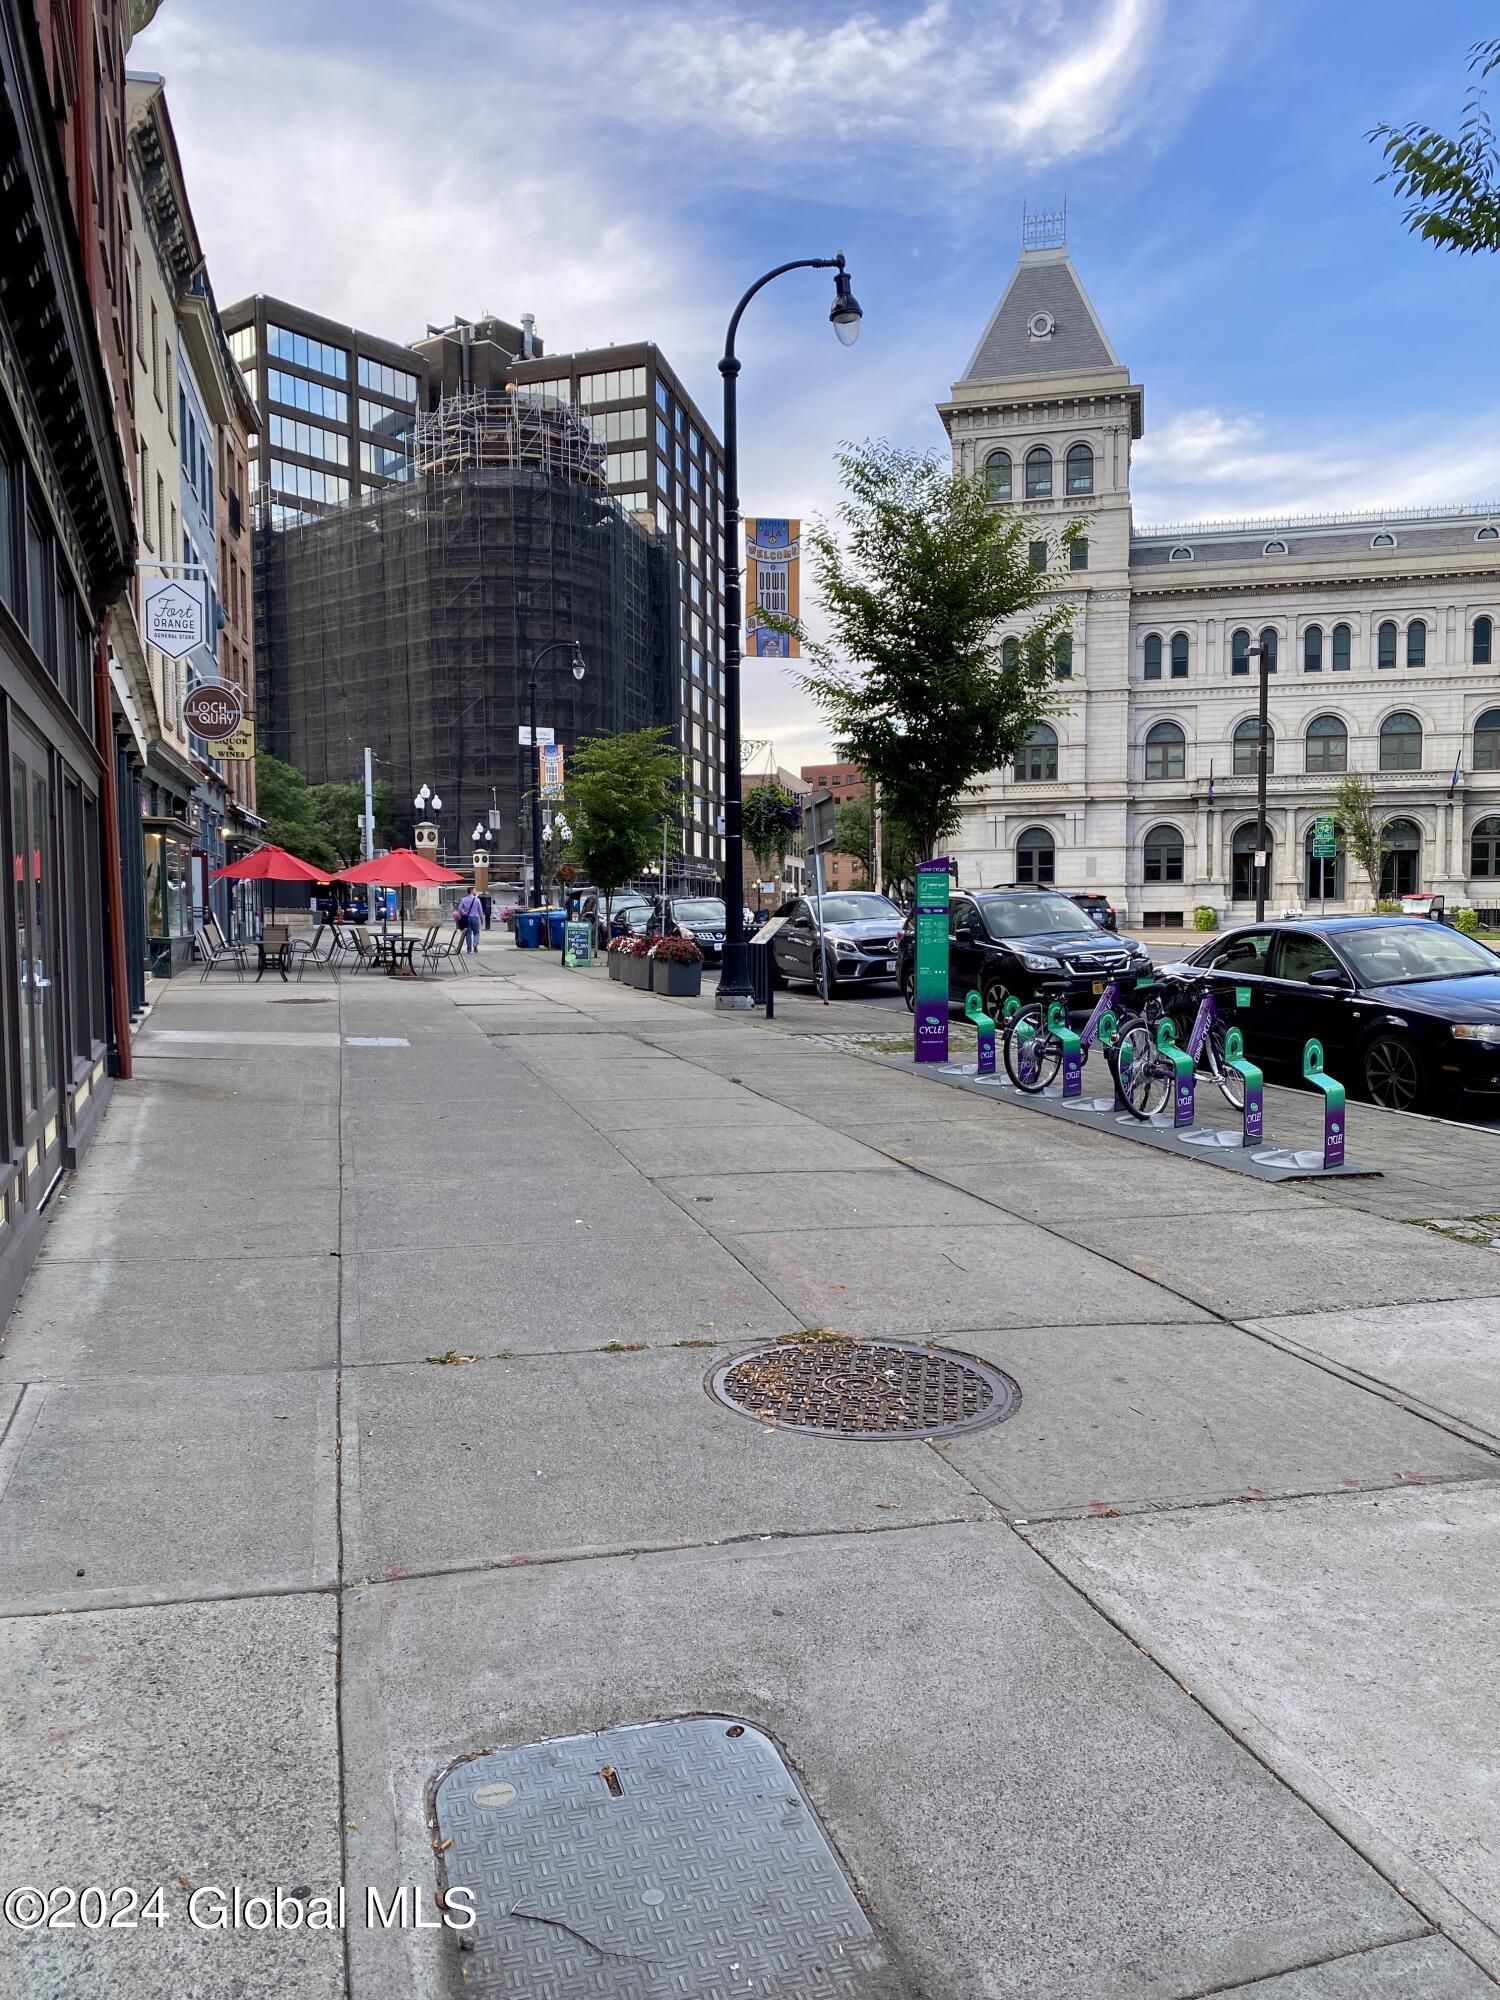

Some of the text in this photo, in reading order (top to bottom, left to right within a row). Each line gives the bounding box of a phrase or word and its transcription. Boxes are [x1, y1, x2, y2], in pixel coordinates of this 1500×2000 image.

[748, 545, 798, 560] WELCOME
[760, 572, 785, 590] DOWN
[154, 597, 194, 618] Fort
[760, 592, 785, 610] TOWN
[153, 618, 195, 629] ORANGE
[192, 700, 227, 713] LOCH
[198, 710, 234, 725] QUAY
[919, 1025, 945, 1034] CYCLE!
